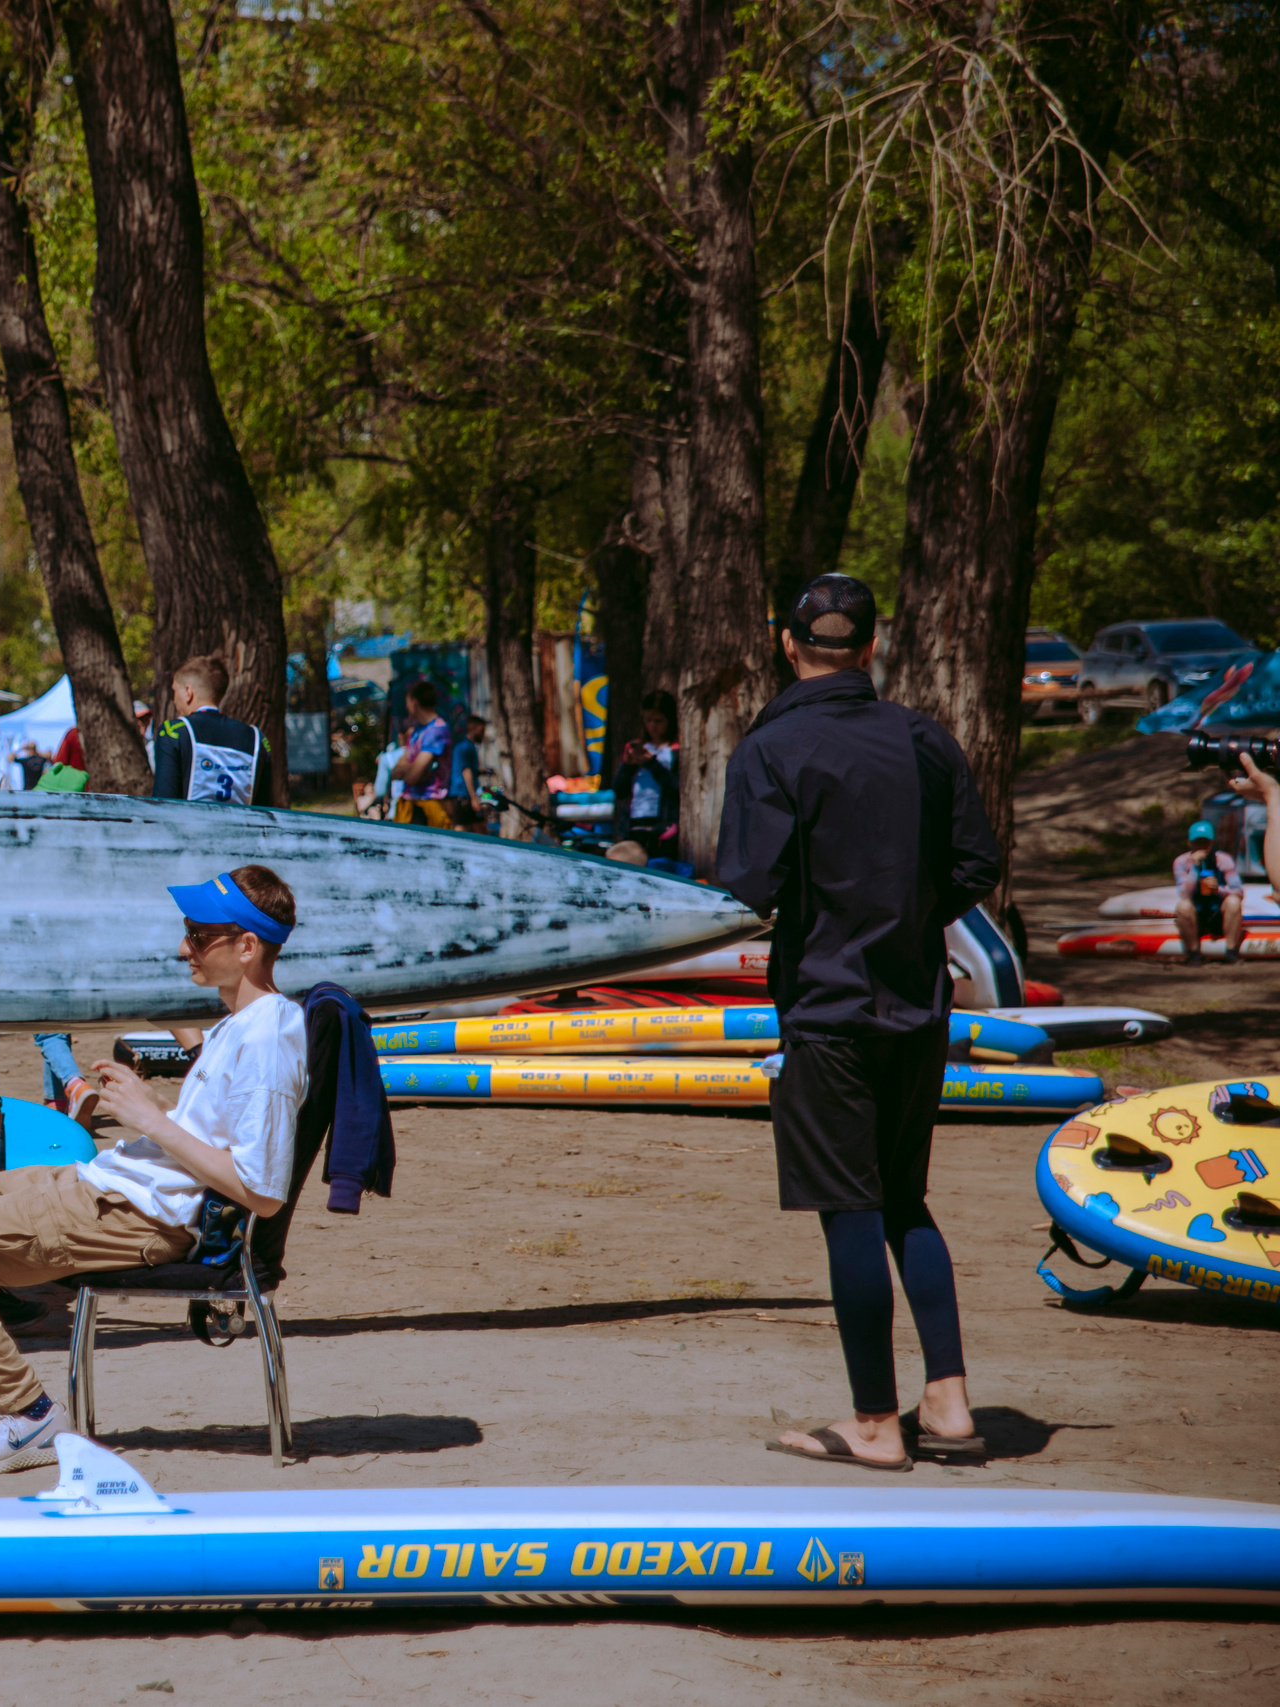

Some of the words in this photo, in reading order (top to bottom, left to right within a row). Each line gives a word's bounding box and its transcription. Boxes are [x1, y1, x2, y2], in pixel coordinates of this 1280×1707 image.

[215, 774, 234, 802] 3
[356, 1542, 549, 1580] SAILOR
[570, 1540, 775, 1577] TUXEDO
